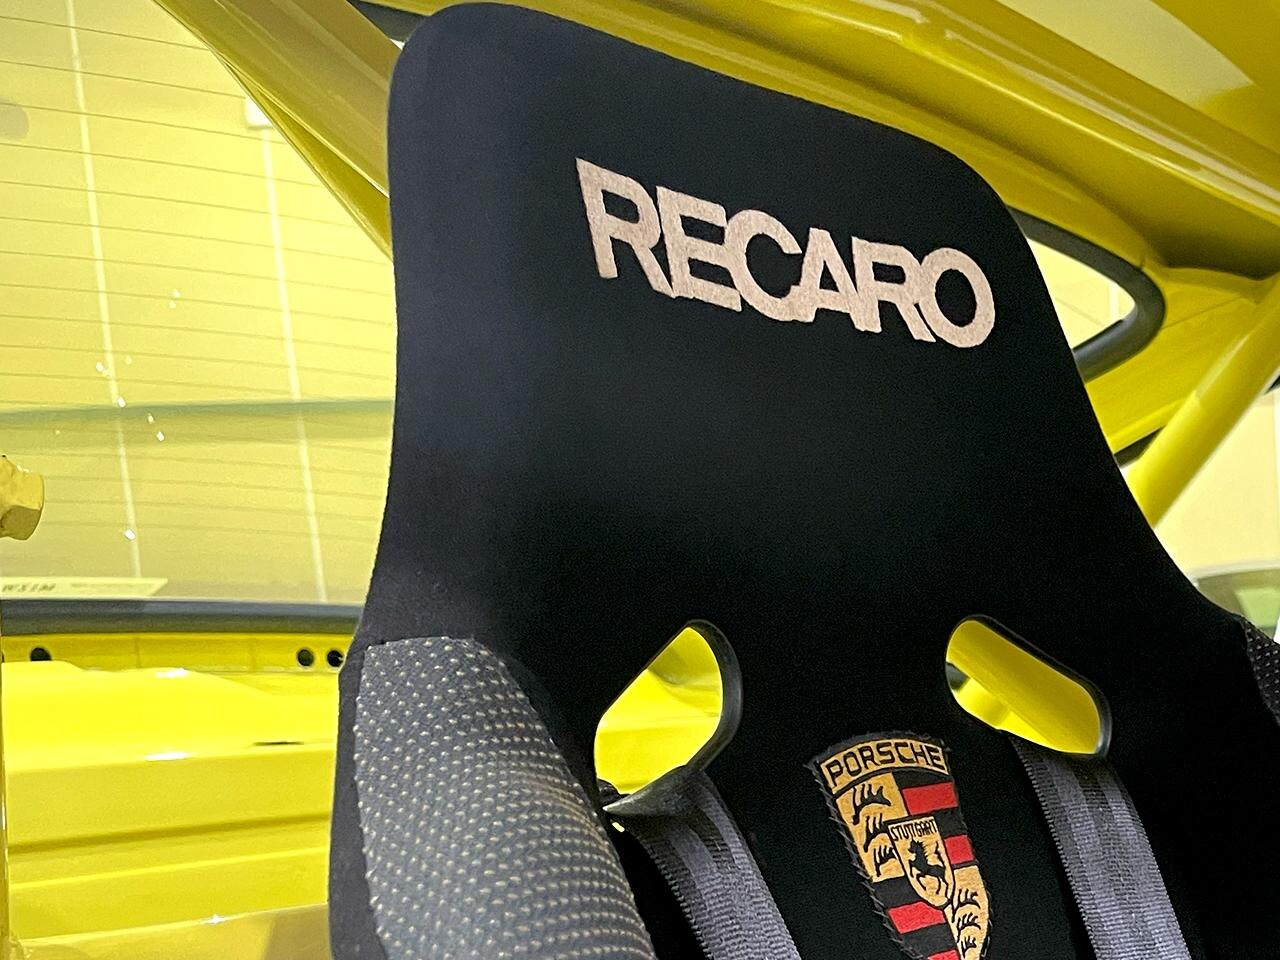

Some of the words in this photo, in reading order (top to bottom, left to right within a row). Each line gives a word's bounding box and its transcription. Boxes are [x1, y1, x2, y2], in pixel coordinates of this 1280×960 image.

[576, 158, 996, 348] RECARO
[825, 742, 946, 787] PORSCHE
[890, 820, 938, 842] STUTTGART
